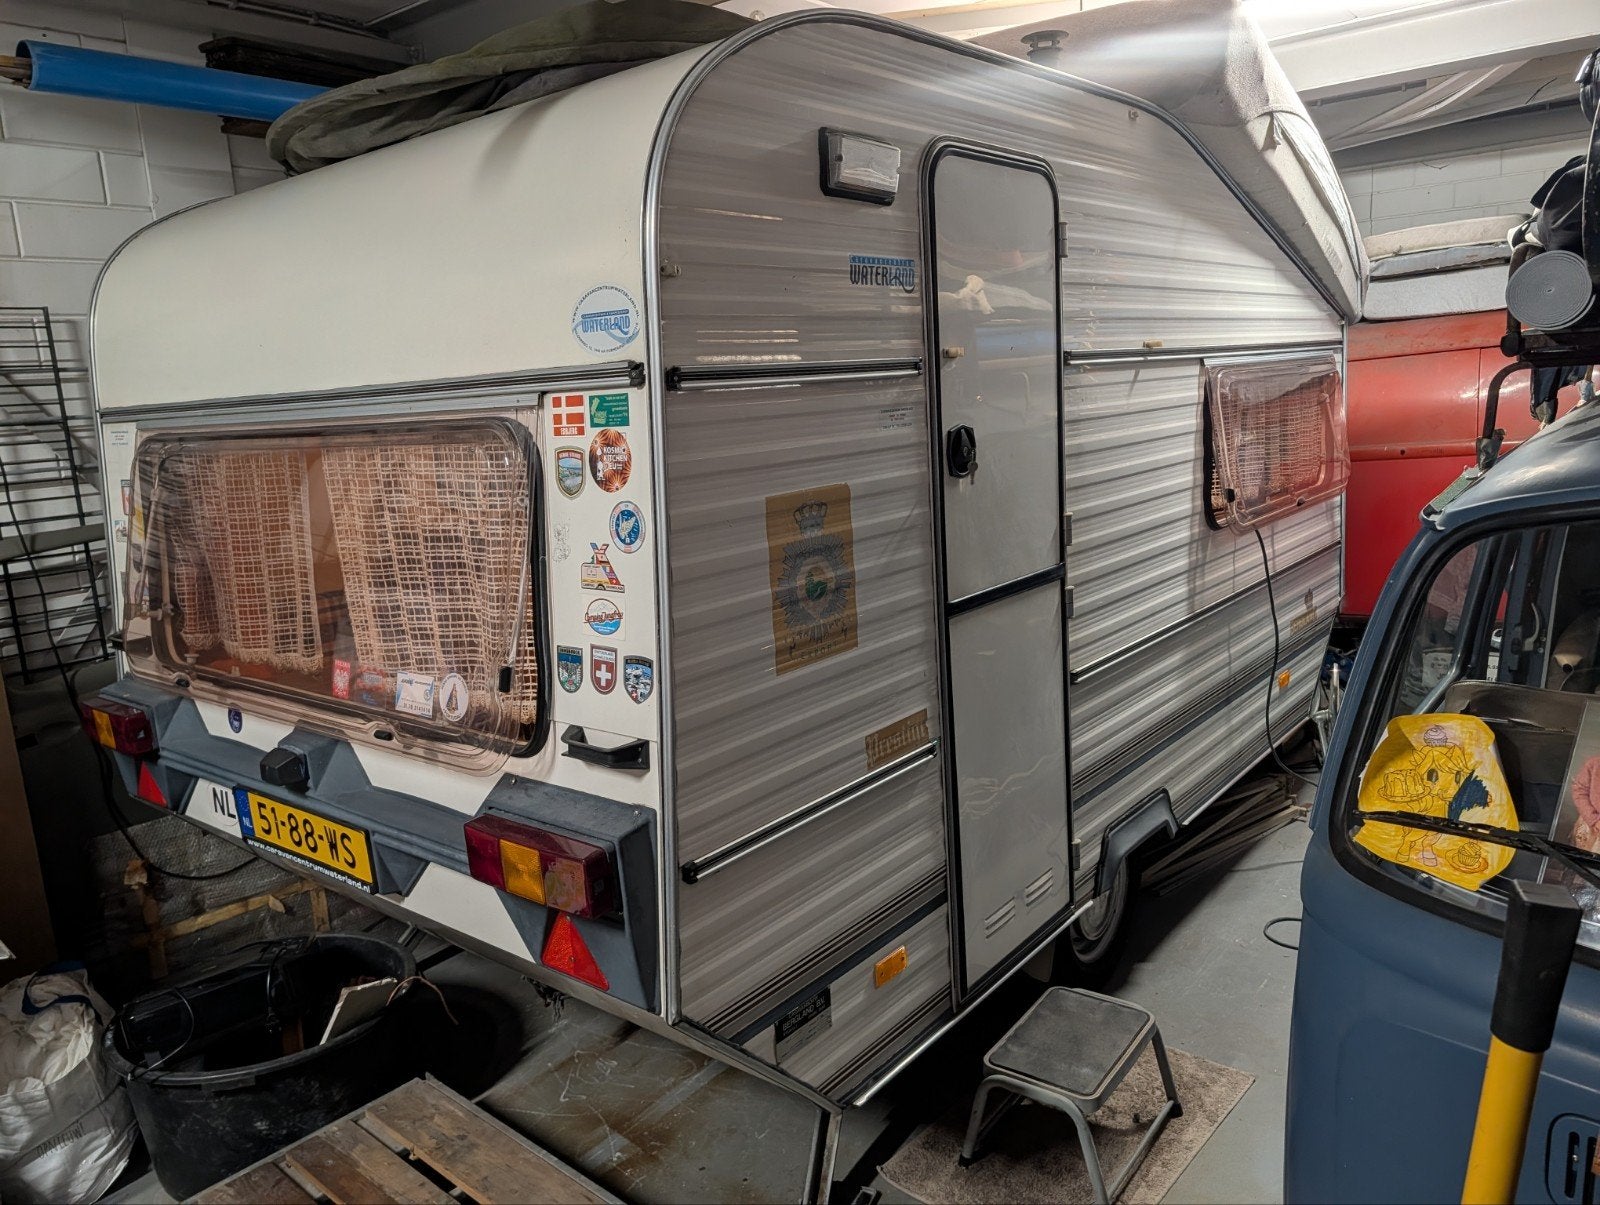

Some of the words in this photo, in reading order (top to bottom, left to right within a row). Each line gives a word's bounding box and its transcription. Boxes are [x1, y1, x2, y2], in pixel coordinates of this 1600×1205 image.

[849, 263, 916, 290] WATERLAND
[581, 315, 631, 334] WATERLAND
[212, 786, 237, 820] NL
[242, 816, 253, 828] NL
[256, 801, 357, 869] 51-88-WS
[246, 838, 371, 894] www.caravancentrumwaterland.nl
